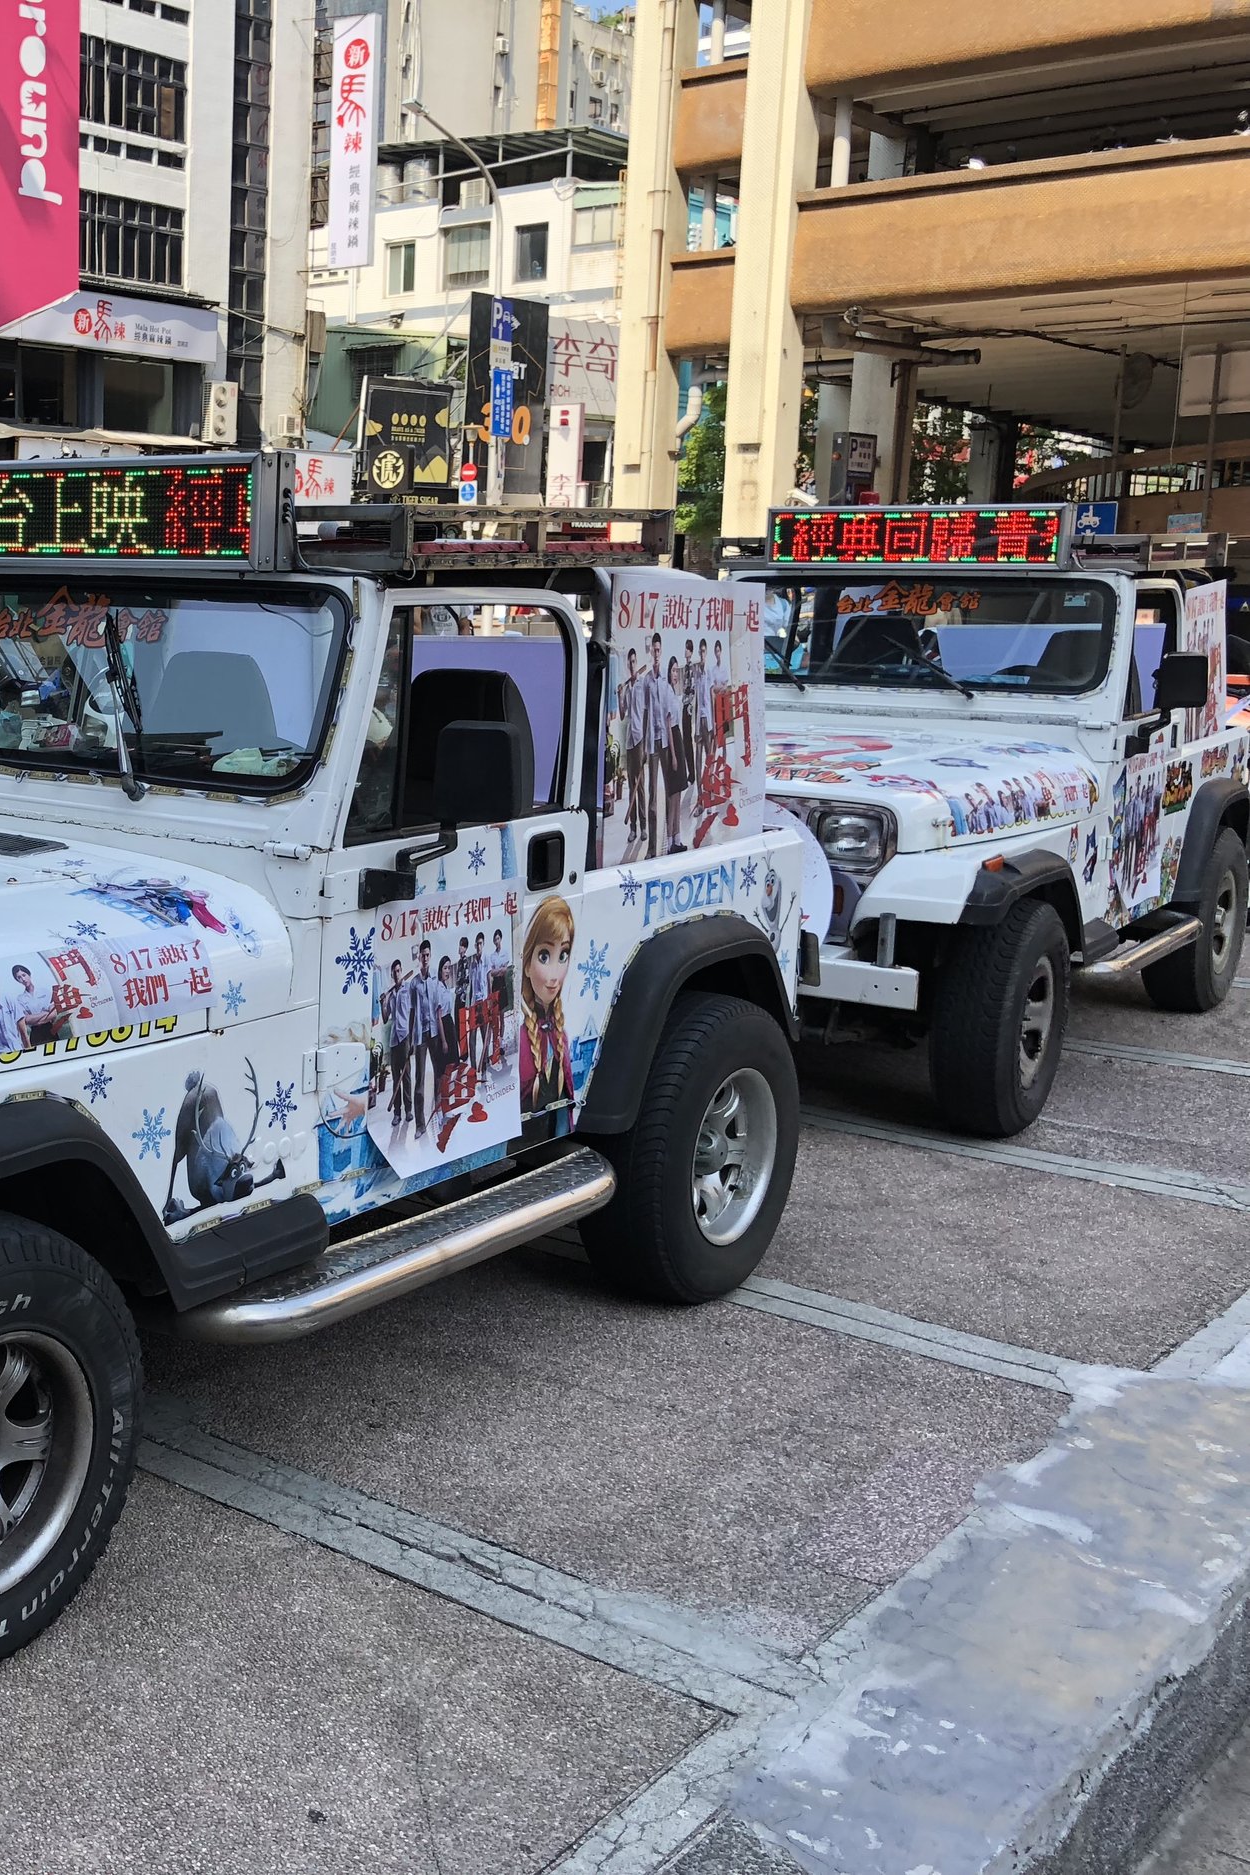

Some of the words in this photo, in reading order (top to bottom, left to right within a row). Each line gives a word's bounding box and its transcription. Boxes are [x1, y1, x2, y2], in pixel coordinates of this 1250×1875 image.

[18, 0, 63, 205] round
[336, 38, 370, 154] 新馬辣
[73, 299, 126, 344] 新馬辣
[135, 323, 148, 332] Mala
[150, 325, 160, 334] Hot
[162, 327, 172, 335] Pot
[493, 302, 504, 328] P
[550, 332, 618, 382] 李奇
[550, 384, 570, 397] RICH
[402, 495, 419, 504] TIGER
[642, 860, 738, 928] FROZEN
[381, 908, 420, 942] 8/17
[422, 892, 518, 934] 說好了我們一起
[109, 948, 153, 975] 8/17
[156, 939, 202, 967] 說好了
[124, 966, 213, 1010] 我們一起
[486, 1083, 517, 1104] OUTSIDERS
